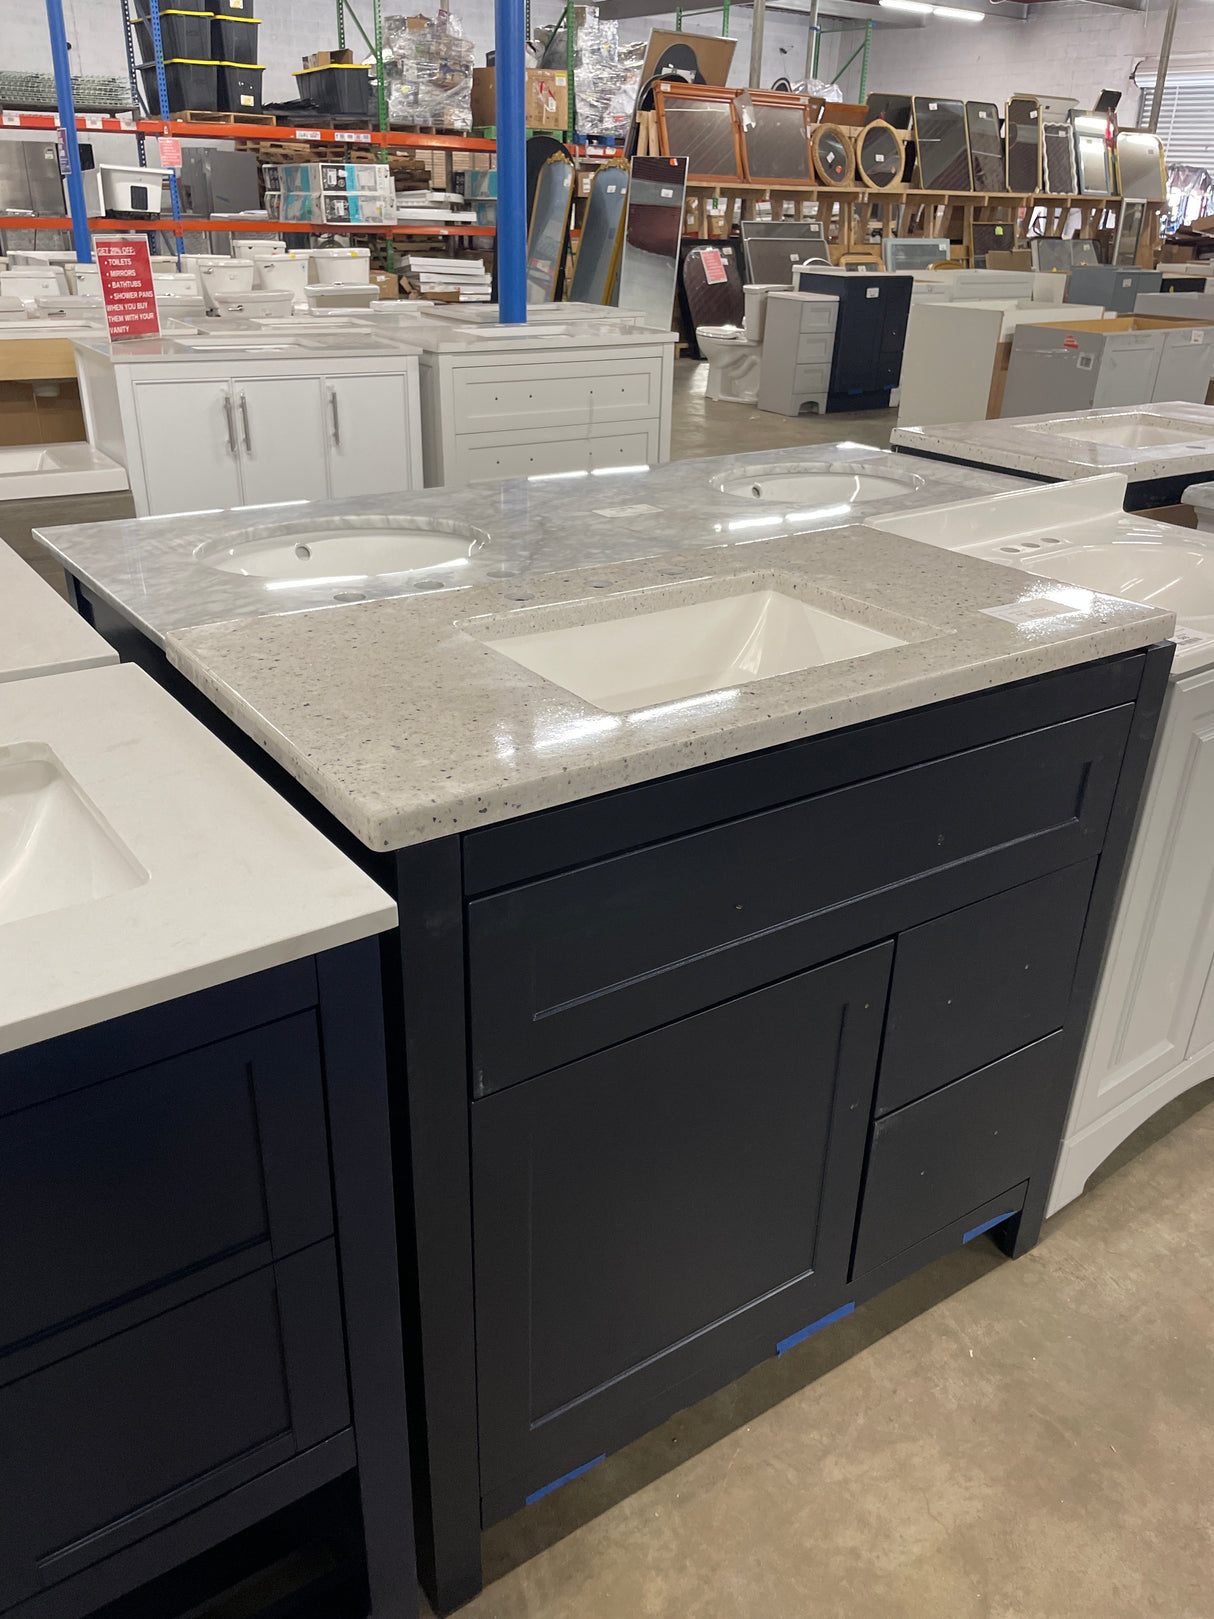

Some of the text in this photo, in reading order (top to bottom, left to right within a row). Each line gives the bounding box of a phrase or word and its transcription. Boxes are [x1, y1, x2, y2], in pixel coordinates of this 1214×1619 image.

[97, 247, 109, 255] GET
[108, 258, 132, 266] TOILETS
[113, 292, 138, 300] SHOWER
[106, 303, 124, 311] WHEN
[124, 313, 139, 321] WITH
[109, 325, 129, 334] VANITY
